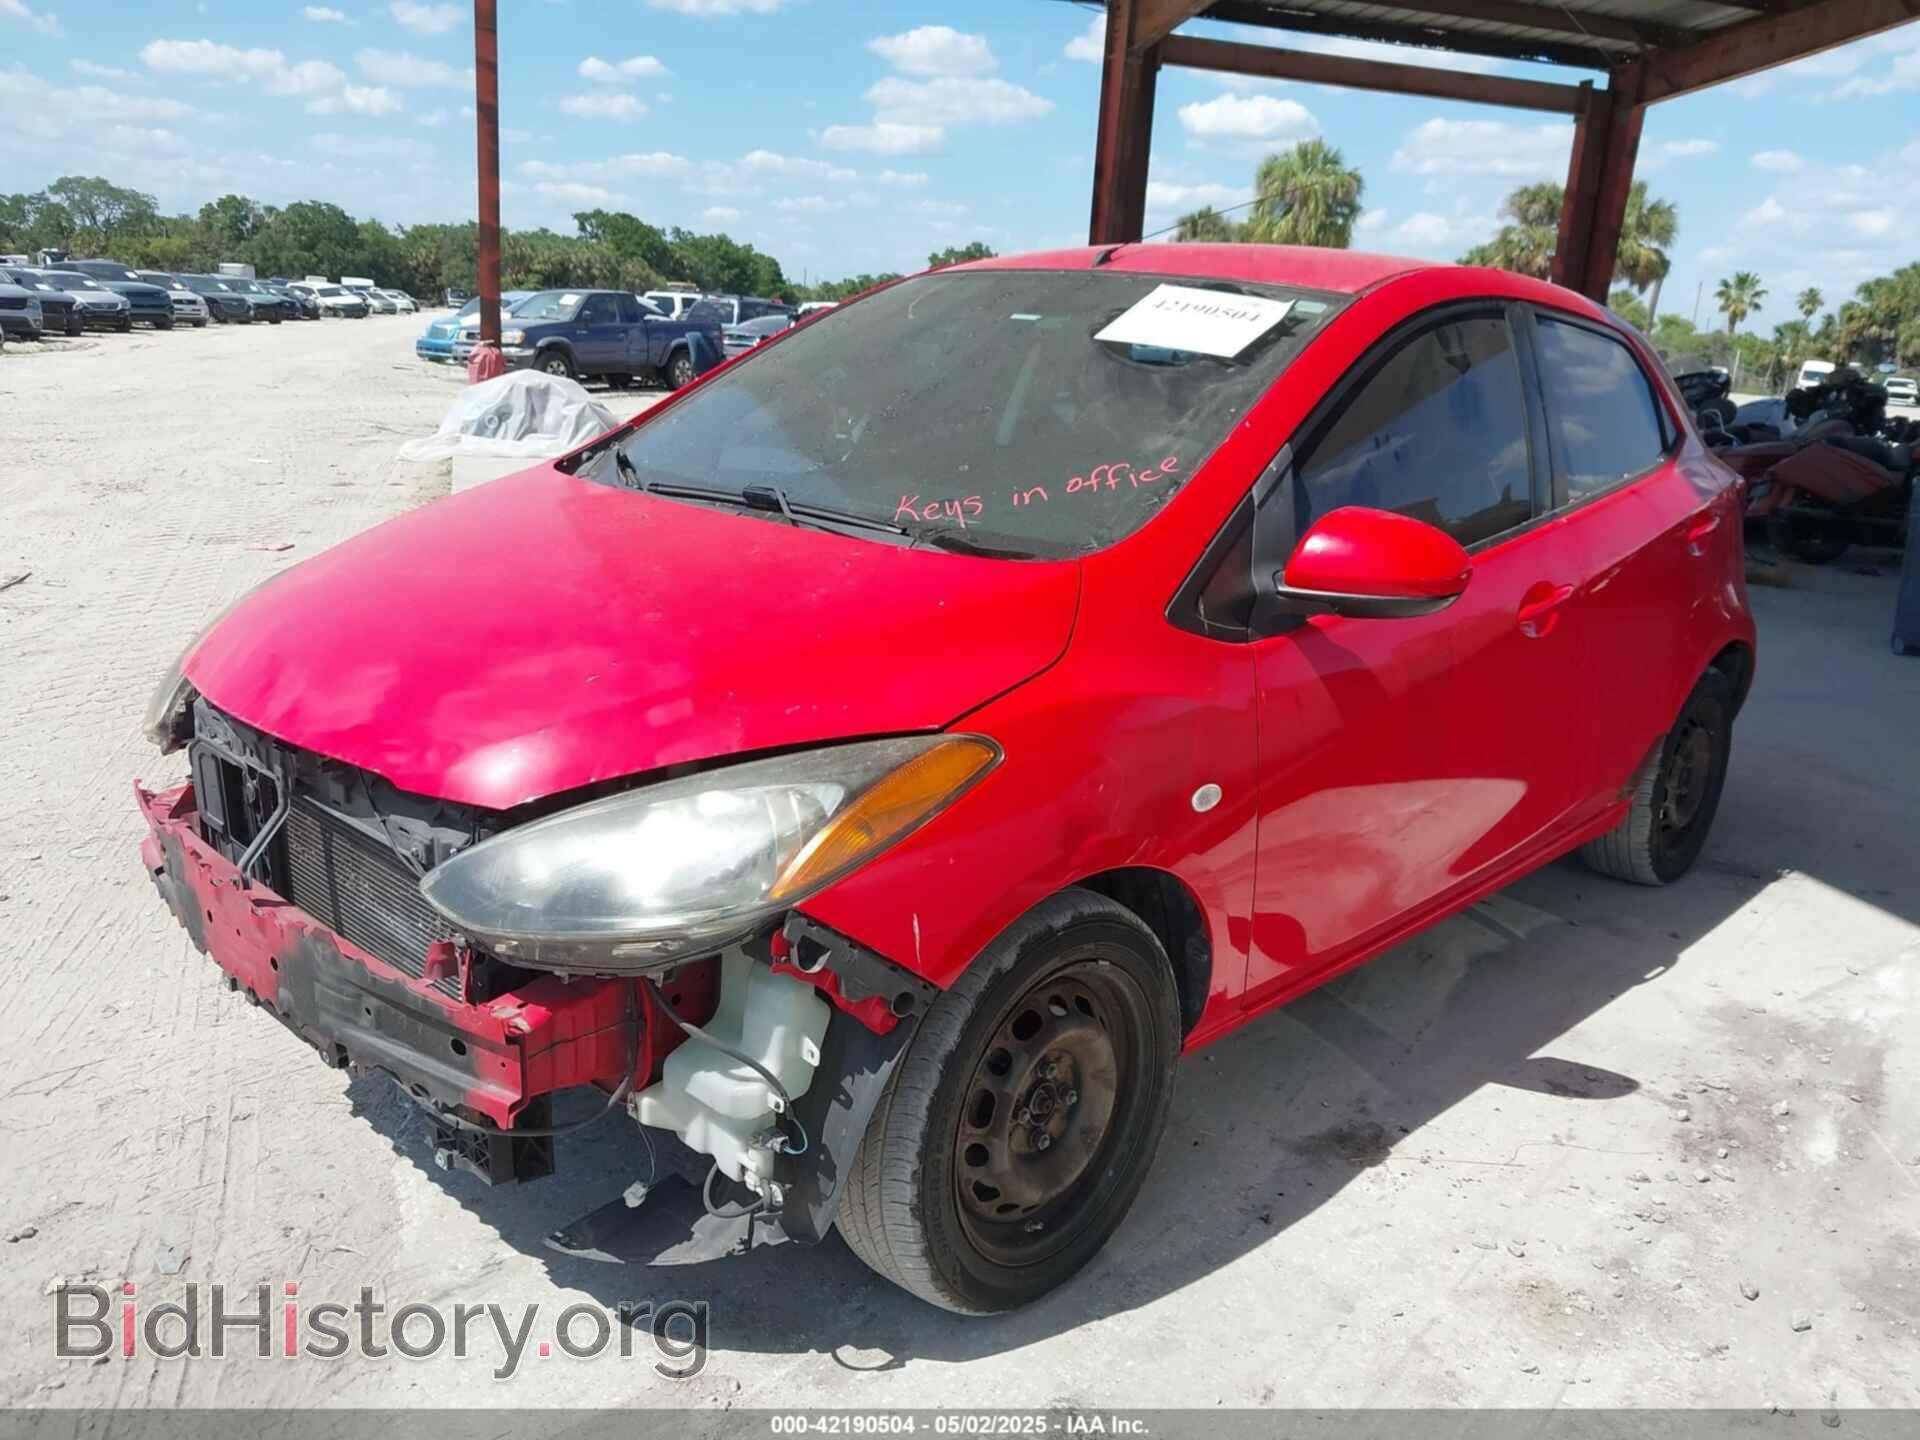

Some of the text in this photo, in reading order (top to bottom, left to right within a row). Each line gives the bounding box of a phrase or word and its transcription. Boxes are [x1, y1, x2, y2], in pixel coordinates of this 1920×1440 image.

[894, 454, 1179, 529] Keys in office
